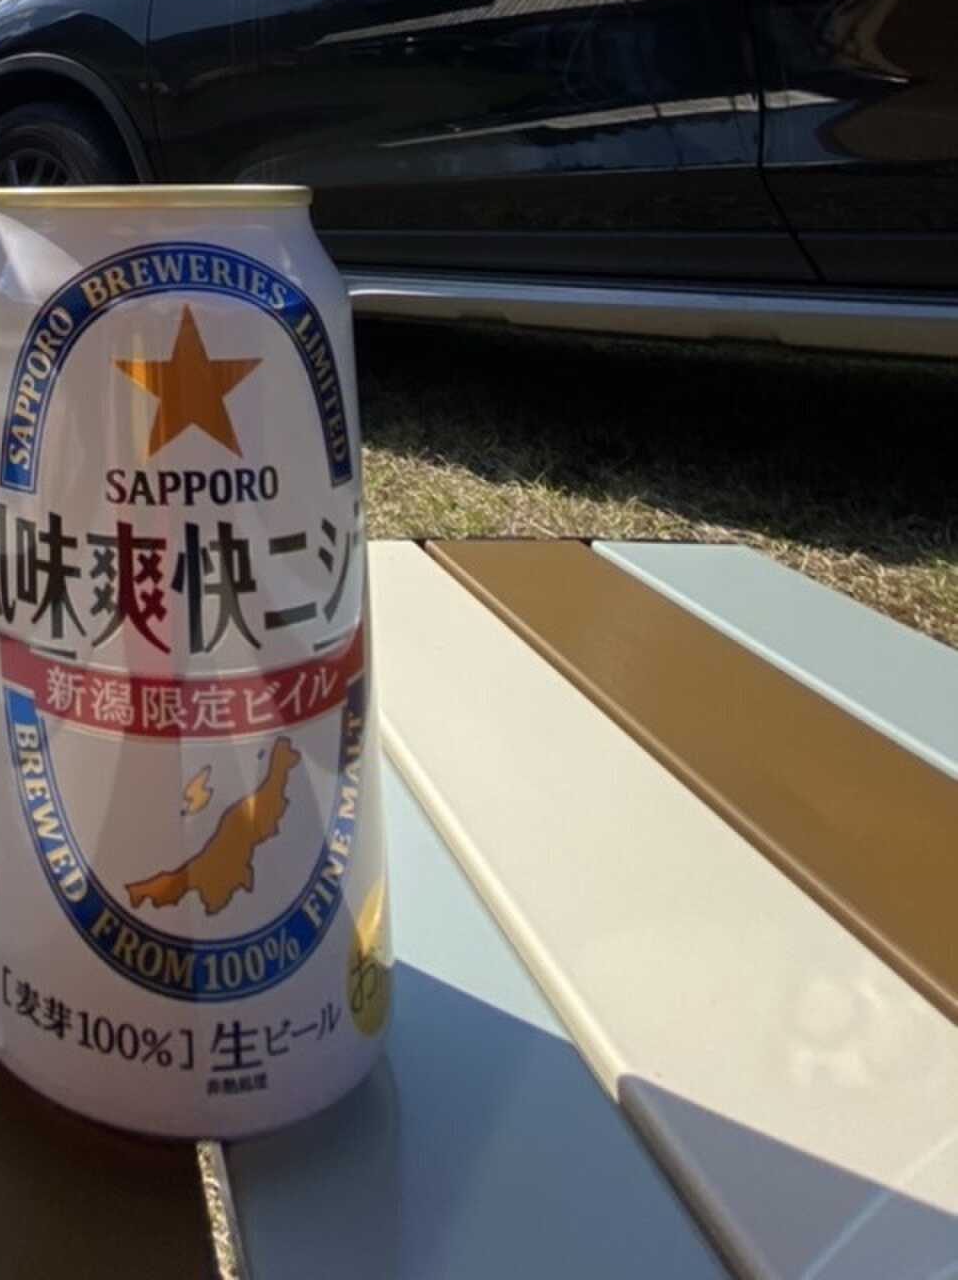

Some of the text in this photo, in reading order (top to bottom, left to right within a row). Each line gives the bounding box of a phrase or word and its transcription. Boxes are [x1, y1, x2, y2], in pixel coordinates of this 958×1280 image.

[8, 306, 75, 472] SAPPORO
[81, 254, 289, 311] BREWERIES
[294, 315, 352, 465] LIMITED
[105, 465, 279, 508] SAPPORO
[46, 665, 338, 731] 新潟限定ビイル
[15, 722, 89, 903] BREWED
[89, 911, 195, 991] FROM
[203, 931, 302, 992] 100%
[301, 829, 353, 930] FINE
[209, 1001, 343, 1072] 生ビール
